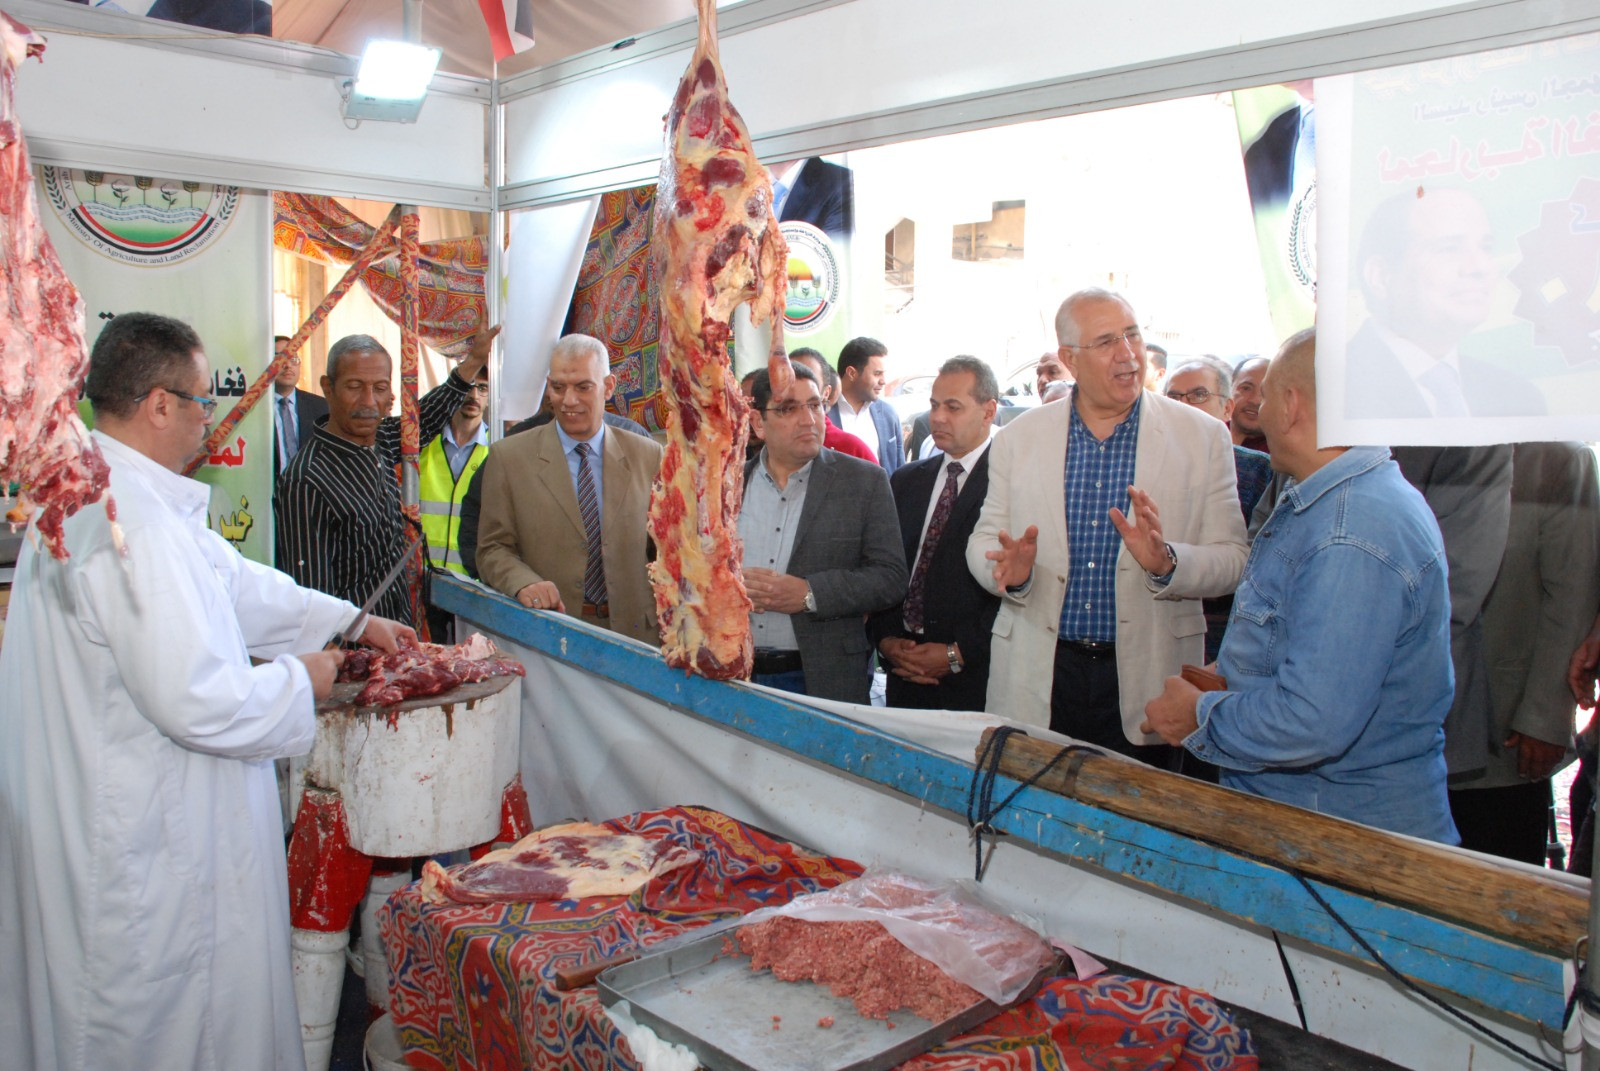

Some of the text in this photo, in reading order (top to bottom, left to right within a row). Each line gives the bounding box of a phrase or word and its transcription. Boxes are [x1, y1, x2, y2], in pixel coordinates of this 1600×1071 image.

[66, 212, 221, 264] Ministry Of Agriculture and Land Reclamation
